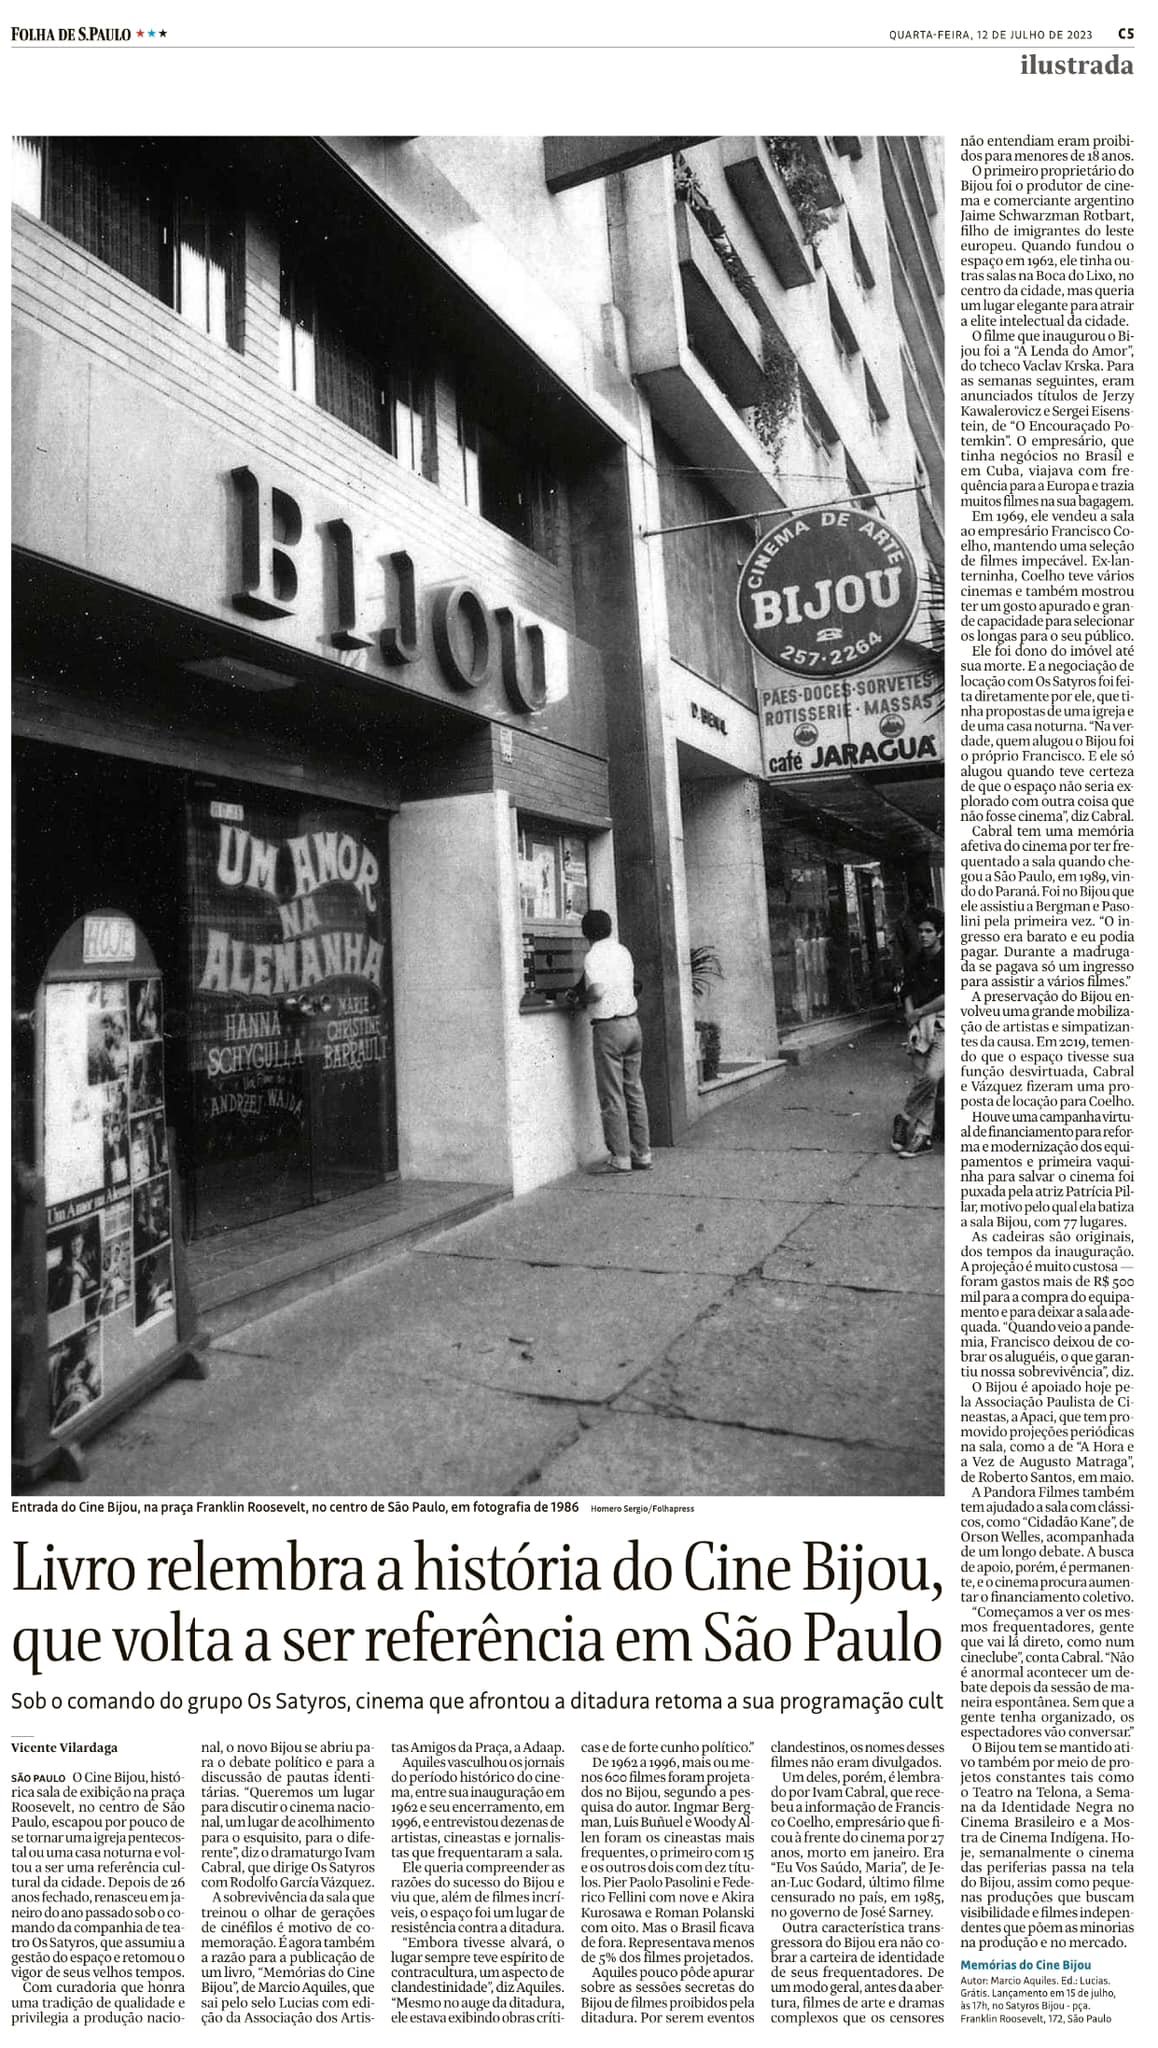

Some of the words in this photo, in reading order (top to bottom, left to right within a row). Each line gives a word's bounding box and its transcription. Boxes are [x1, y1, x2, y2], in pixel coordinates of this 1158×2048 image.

[890, 31, 973, 40] QUARTA-FEIRA,
[978, 30, 988, 39] 12
[992, 31, 1006, 39] DE
[1011, 30, 1044, 39] JULHO
[1049, 31, 1063, 39] DE
[1068, 30, 1092, 39] 2023
[1119, 28, 1134, 39] C5
[1021, 54, 1133, 74] ilustrada
[961, 210, 995, 222] Jaime
[999, 209, 1079, 221] Schwarzman
[1084, 208, 1134, 222] Rotbart,
[748, 521, 810, 589] CINEMA
[821, 512, 850, 527] DE
[858, 521, 904, 565] ARTE
[961, 569, 1017, 582] terninha,
[1022, 569, 1064, 581] Coelho
[1069, 572, 1093, 581] teve
[1097, 570, 1134, 581] vários
[230, 465, 549, 714] BIJOU
[751, 567, 902, 629] BIJOU
[765, 703, 852, 726] ROTISSERIE
[864, 695, 933, 715] MASSAS
[769, 749, 803, 773] café
[217, 824, 279, 896] UM
[286, 832, 379, 912] AMOR
[278, 897, 323, 940] NA
[199, 929, 384, 994] ALEMANHA
[224, 1011, 281, 1041] HANNA
[207, 1039, 305, 1079] SCHYGULLA
[961, 1274, 997, 1287] foram
[1001, 1274, 1040, 1290] gastos
[1043, 1276, 1072, 1286] mais
[1076, 1275, 1090, 1287] de
[1094, 1276, 1109, 1288] R$
[1112, 1279, 1134, 1289] 500
[12, 1501, 58, 1512] Entrada
[61, 1501, 76, 1512] do
[79, 1501, 104, 1512] Cine
[108, 1501, 140, 1515] Bijou,
[144, 1504, 158, 1512] na
[161, 1504, 193, 1515] praça
[197, 1501, 244, 1512] Franklin
[248, 1501, 308, 1514] Roosevelt,
[312, 1504, 326, 1512] no
[330, 1503, 367, 1512] centro
[371, 1501, 384, 1512] de
[388, 1502, 409, 1512] São
[413, 1501, 448, 1514] Paulo,
[451, 1504, 470, 1512] em
[473, 1501, 530, 1515] fotografia
[534, 1501, 548, 1512] de
[551, 1502, 579, 1512] 1986
[624, 1504, 694, 1514] Sergio/Folhapress
[13, 1541, 135, 1591] Livro
[147, 1539, 366, 1591] relembra
[378, 1557, 404, 1591] a
[414, 1539, 602, 1591] história
[614, 1539, 672, 1591] do
[685, 1541, 791, 1591] Cine
[803, 1541, 942, 1604] Bijou,
[13, 1628, 101, 1676] que
[112, 1610, 233, 1662] volta
[245, 1628, 272, 1662] a
[283, 1628, 355, 1662] ser
[365, 1610, 605, 1662] referência
[616, 1628, 692, 1662] em
[705, 1612, 791, 1662] São
[804, 1610, 941, 1662] Paulo
[12, 1691, 46, 1709] Sob
[52, 1696, 62, 1709] o
[68, 1691, 154, 1709] comando
[160, 1691, 182, 1709] do
[188, 1696, 242, 1714] grupo
[248, 1693, 271, 1709] Os
[276, 1693, 350, 1714] Satyros,
[356, 1692, 423, 1709] cinema
[430, 1696, 464, 1714] que
[469, 1691, 549, 1709] afrontou
[555, 1696, 564, 1709] a
[571, 1691, 649, 1709] ditadura
[656, 1694, 722, 1709] retoma
[728, 1697, 737, 1709] a
[743, 1696, 774, 1709] sua
[781, 1692, 903, 1714] programação
[909, 1691, 944, 1709] cult
[11, 1742, 56, 1752] Vicente
[60, 1742, 117, 1755] Vilardaga
[11, 1772, 31, 1782] SÃO
[73, 1772, 82, 1782] O
[85, 1771, 111, 1782] Cine
[114, 1771, 148, 1785] Bijou,
[151, 1771, 184, 1782] histó-
[392, 1802, 418, 1814] 1962
[420, 1804, 426, 1812] e
[429, 1804, 450, 1812] seu
[452, 1804, 542, 1813] encerramento,
[545, 1804, 564, 1812] em
[202, 1861, 245, 1873] Cabral,
[248, 1865, 270, 1876] que
[273, 1861, 308, 1876] dirige
[311, 1862, 327, 1872] Os
[329, 1862, 375, 1876] Satyros
[582, 1908, 641, 1918] Kurosawa
[645, 1910, 652, 1918] e
[655, 1908, 699, 1918] Roman
[703, 1906, 754, 1918] Polanski
[771, 1909, 787, 1917] no
[790, 1909, 840, 1920] governo
[843, 1906, 857, 1917] de
[861, 1906, 886, 1919] José
[889, 1907, 933, 1920] Sarney.
[961, 1960, 1016, 1970] Memórias
[1019, 1959, 1033, 1970] do
[1036, 1960, 1059, 1970] Cine
[1063, 1960, 1091, 1972] Bijou
[961, 1977, 988, 1985] Autor:
[991, 1976, 1021, 1985] Marcio
[1024, 1976, 1058, 1987] Aquiles.
[1062, 1976, 1077, 1985] Ed.:
[1080, 1976, 1110, 1985] Lucias.
[961, 1988, 989, 1997] Grátis.
[992, 1989, 1048, 1999] Lançamento
[1067, 1989, 1075, 1997] 15
[1078, 1989, 1088, 1997] de
[1091, 1988, 1115, 1999] julho,
[961, 2014, 997, 2023] Franklin
[1000, 2014, 1045, 2024] Roosevelt,
[1049, 2015, 1065, 2024] 172,
[1068, 2014, 1084, 2023] São
[1087, 2014, 1111, 2023] Paulo
